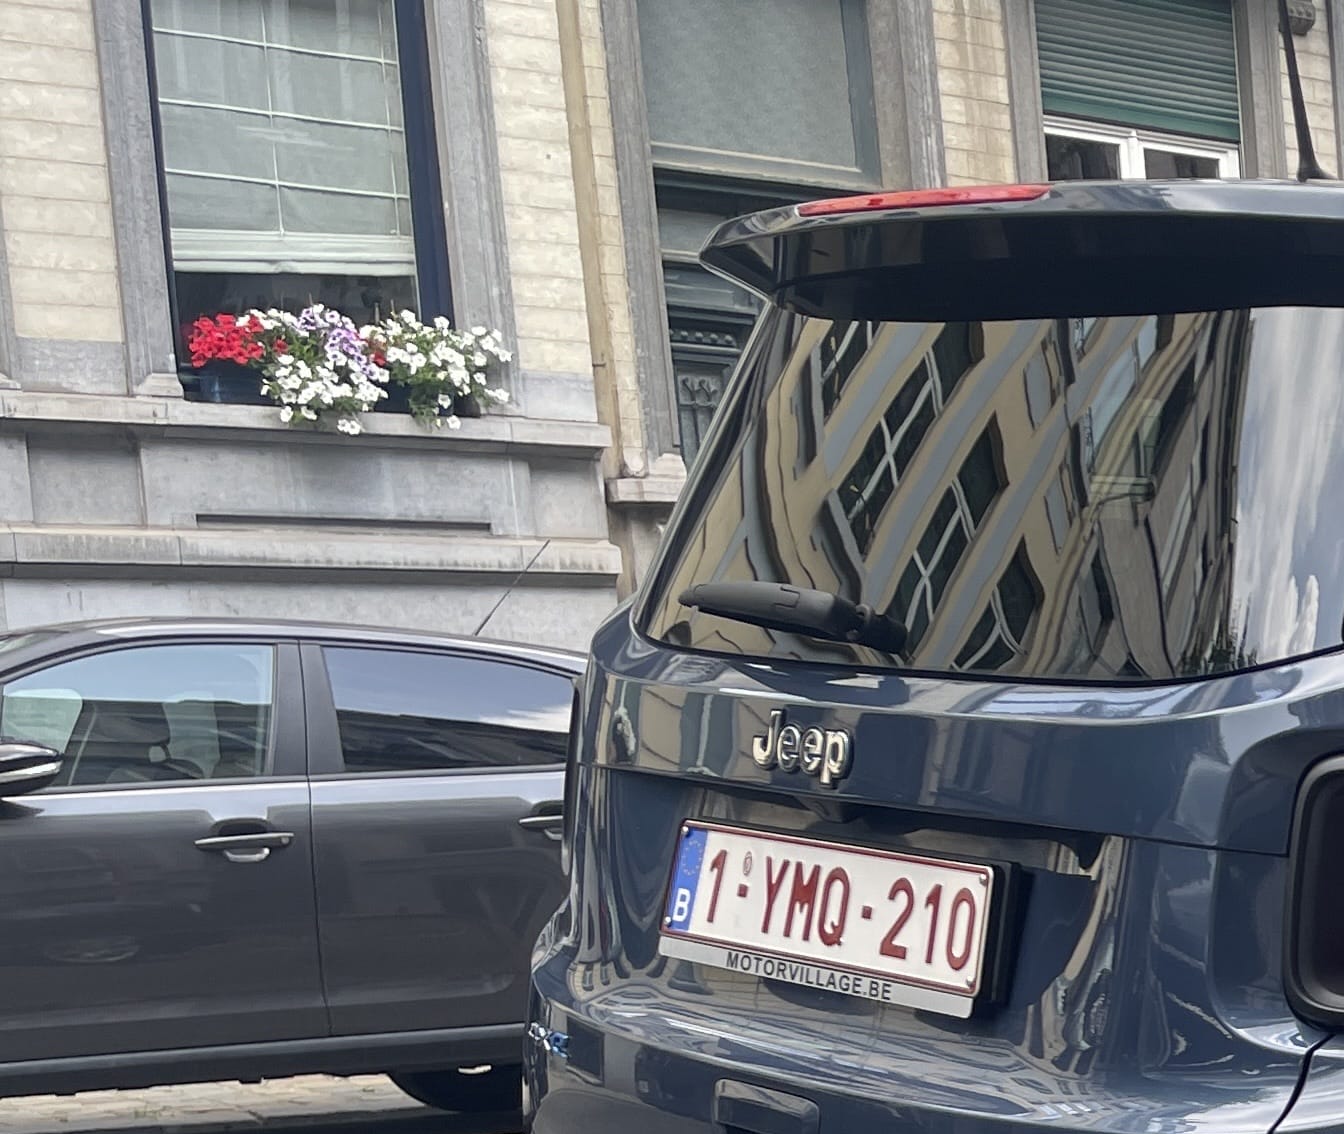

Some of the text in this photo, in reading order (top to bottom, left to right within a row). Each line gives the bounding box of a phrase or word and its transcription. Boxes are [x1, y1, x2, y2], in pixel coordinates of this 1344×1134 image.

[752, 708, 853, 788] Jeep
[672, 887, 690, 922] B
[726, 951, 892, 1001] MOTORVILLAGE.BE
